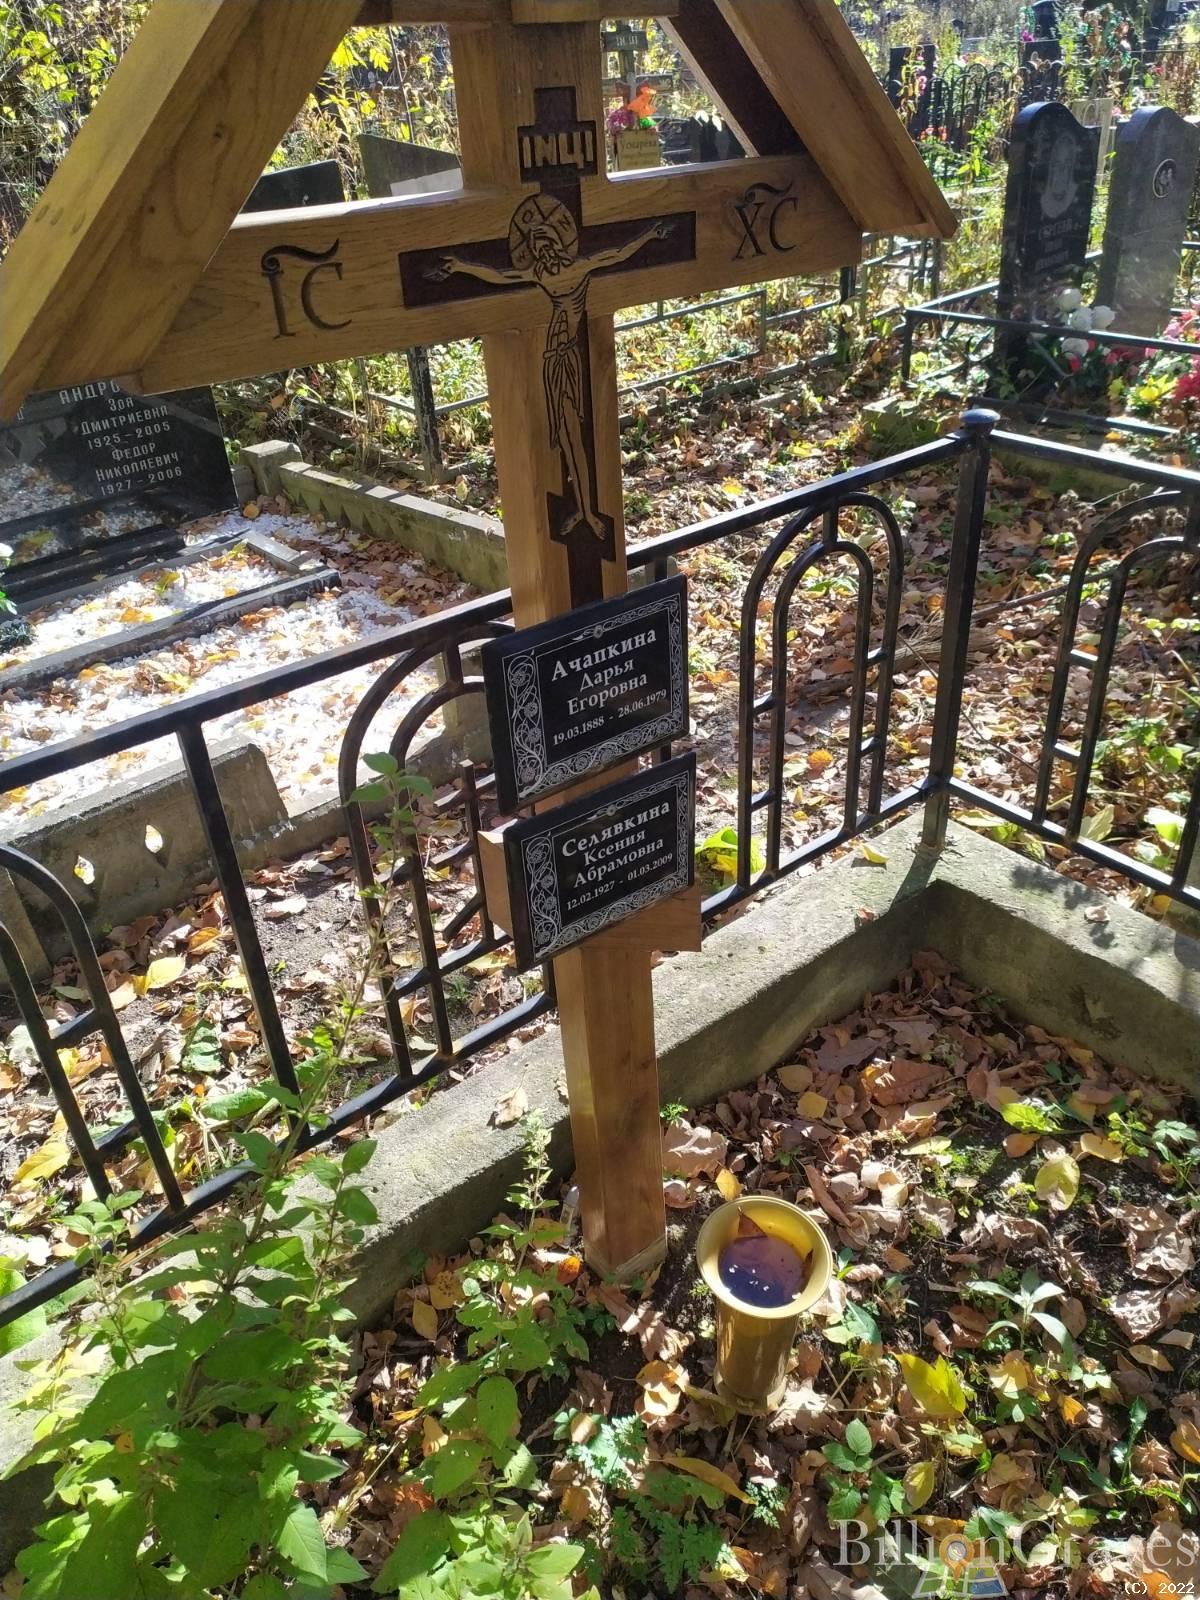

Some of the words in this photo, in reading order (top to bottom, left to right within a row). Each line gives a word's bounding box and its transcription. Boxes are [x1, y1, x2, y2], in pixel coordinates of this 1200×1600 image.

[81, 405, 169, 436] ДМИТРИЕВНА
[96, 452, 179, 482] НИКОЛАЕВИЧ
[112, 442, 156, 461] ФЕДОР
[551, 629, 657, 682] Ачапкина
[579, 659, 635, 692] Дарья
[567, 673, 648, 715] Егоровна
[553, 715, 605, 745] 19.03.1888
[617, 688, 667, 717] 28.06.1979
[562, 801, 671, 857] Селявкина
[584, 830, 646, 866] Ксения
[566, 881, 615, 910] 12.02.1927
[627, 853, 674, 881] 01.03.2009
[574, 838, 664, 888] Абрамовна
